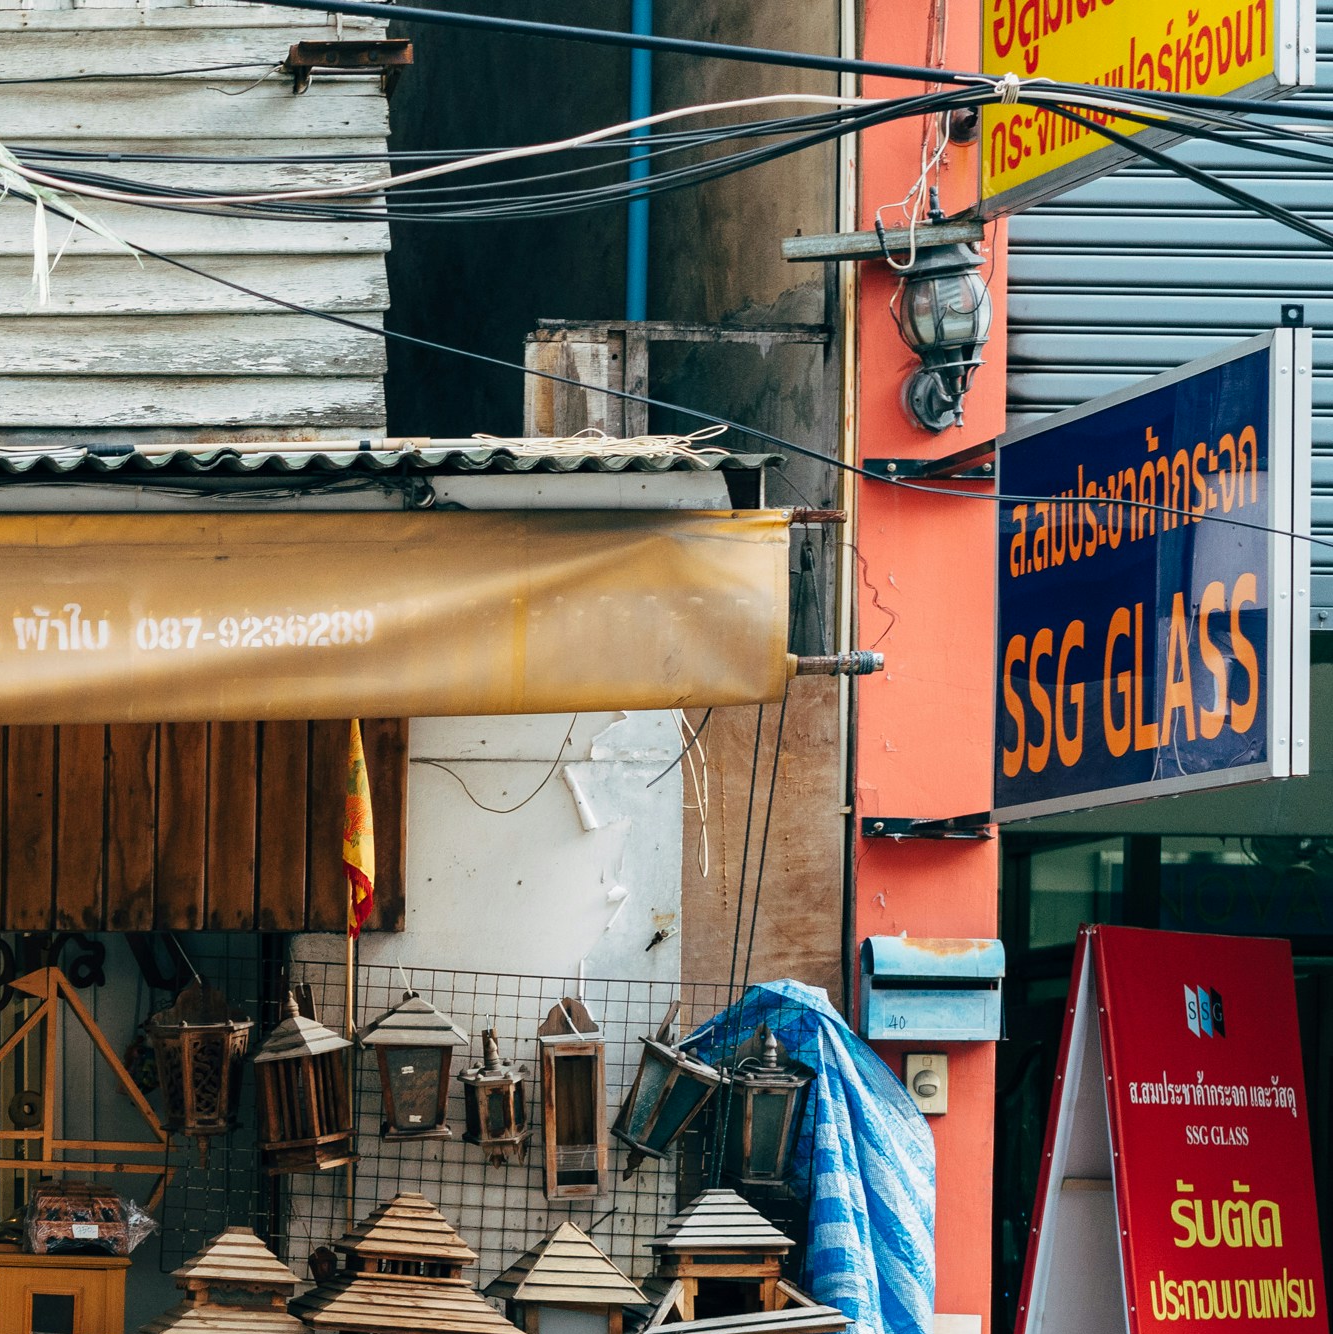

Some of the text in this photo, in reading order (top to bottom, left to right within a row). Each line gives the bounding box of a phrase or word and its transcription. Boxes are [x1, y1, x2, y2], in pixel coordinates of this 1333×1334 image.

[1002, 573, 1259, 778] SSG GLASS
[888, 1015, 906, 1030] 40
[1187, 1000, 1223, 1022] SSG
[1186, 1124, 1249, 1147] SSG GLASS
[1170, 1178, 1283, 1249] รับตัด
